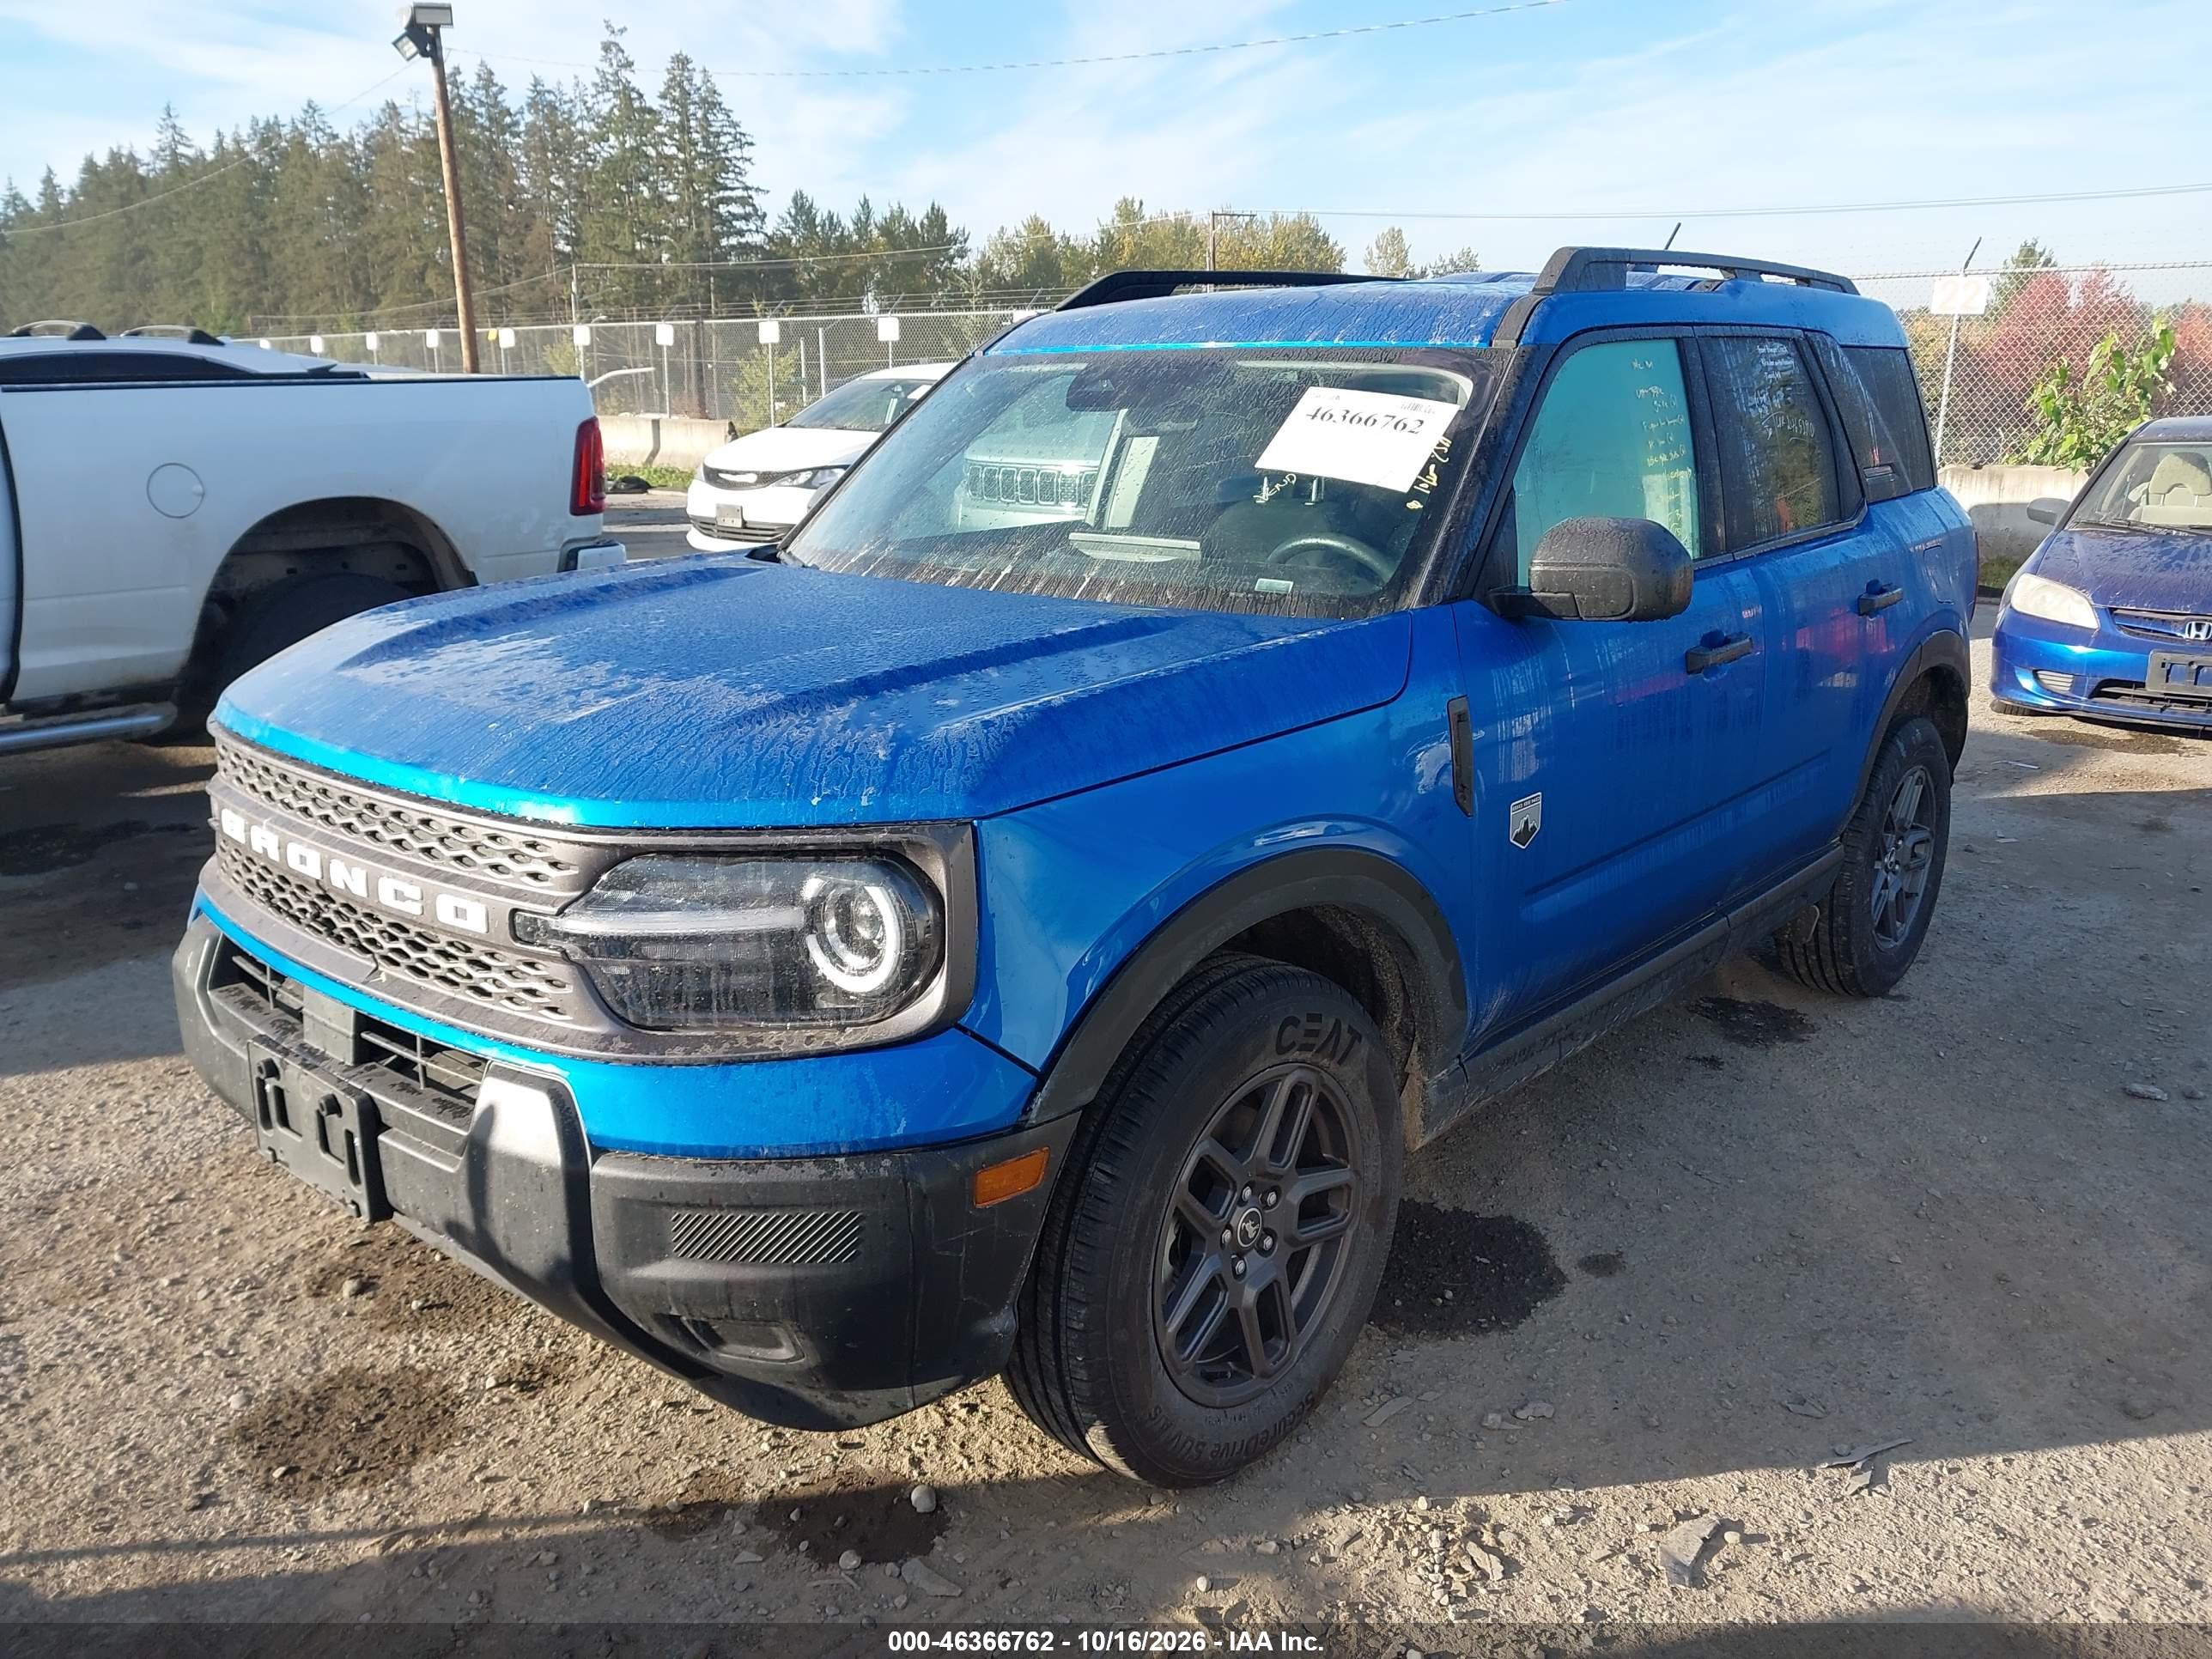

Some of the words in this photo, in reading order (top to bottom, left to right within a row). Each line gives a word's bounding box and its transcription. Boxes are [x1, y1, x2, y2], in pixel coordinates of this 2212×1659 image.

[1306, 405, 1425, 434] 46366762
[221, 807, 489, 934] BRONCO
[1275, 1012, 1363, 1066] CEAT
